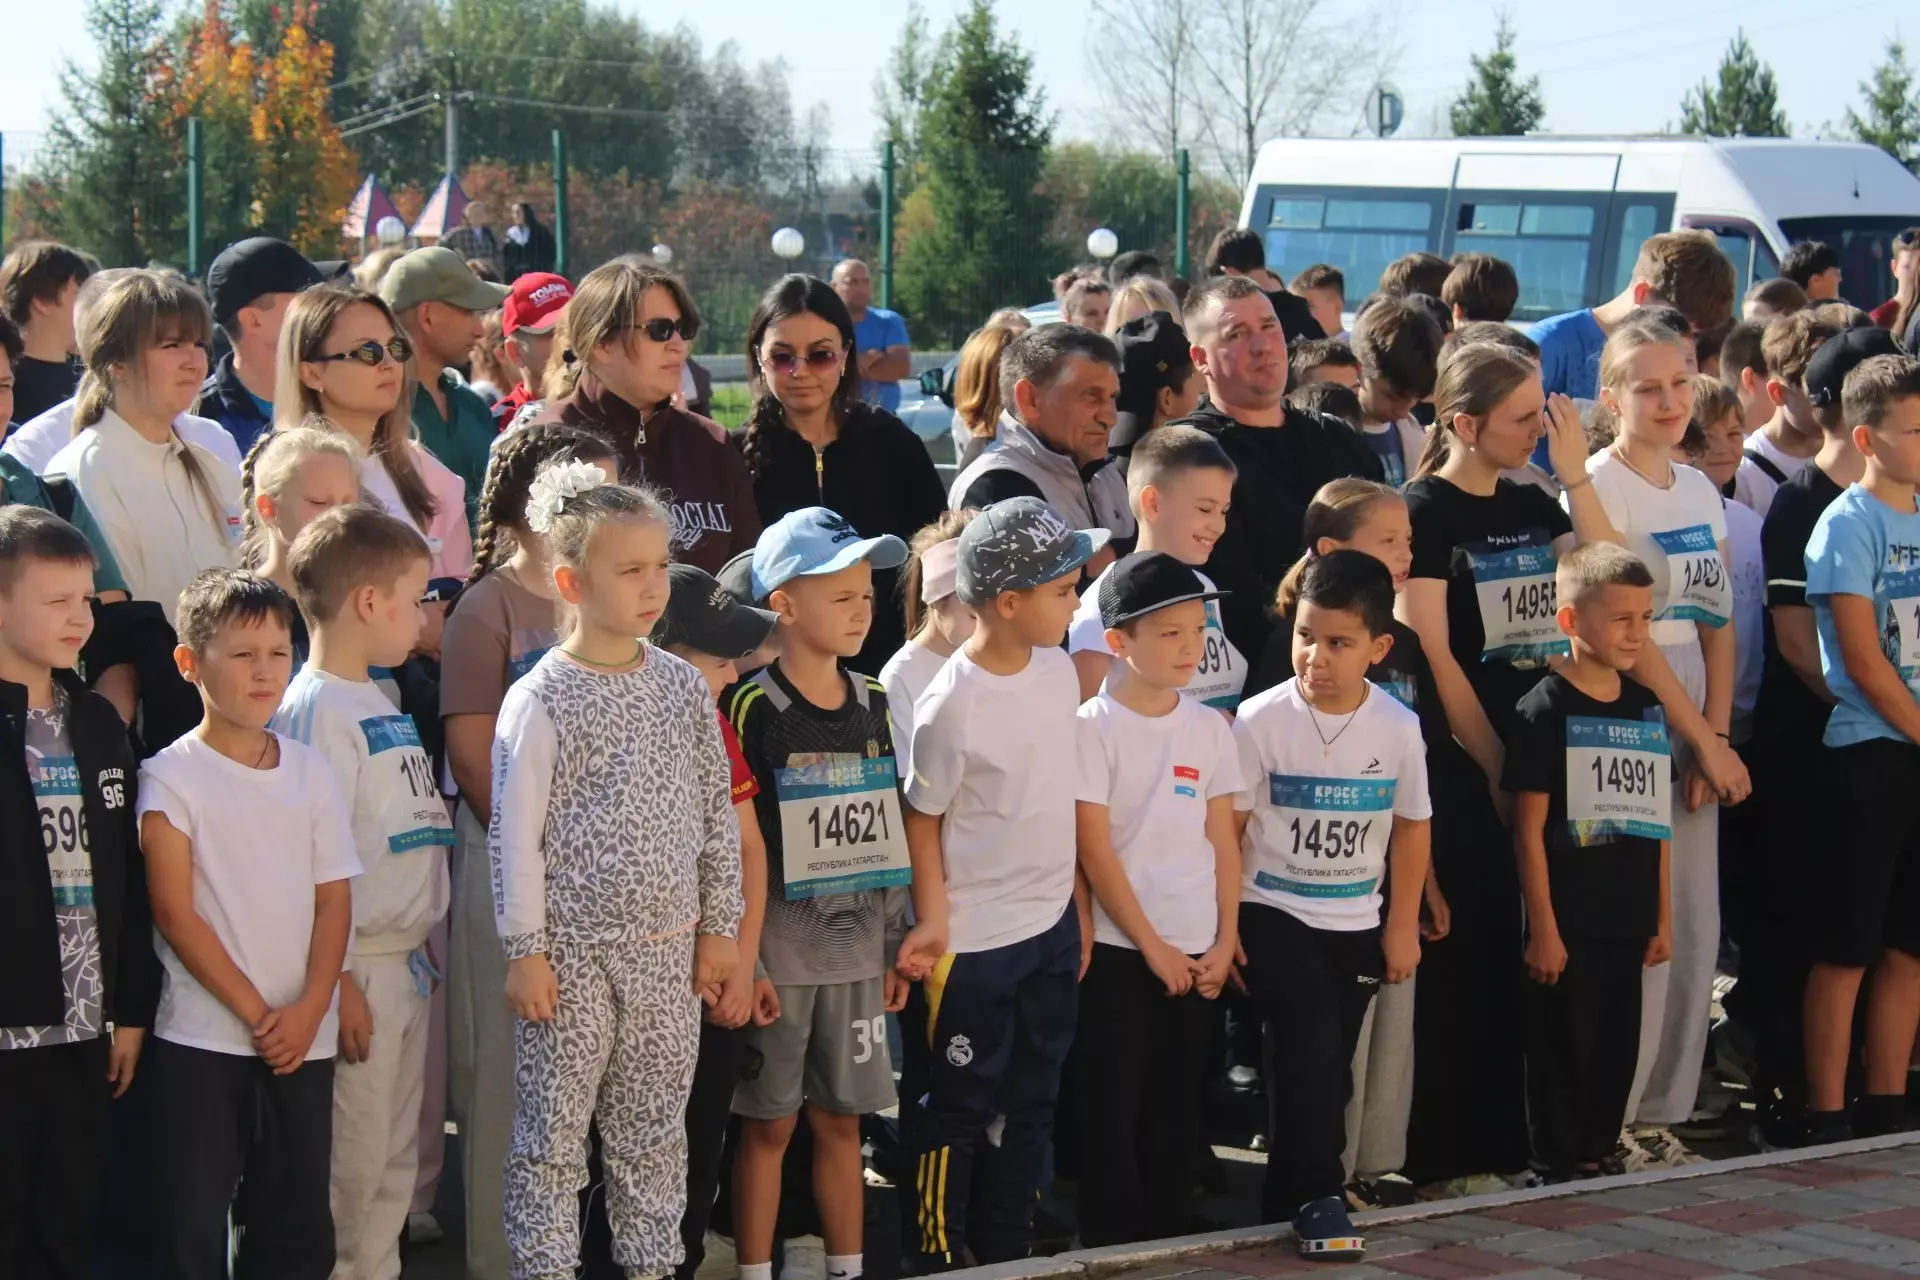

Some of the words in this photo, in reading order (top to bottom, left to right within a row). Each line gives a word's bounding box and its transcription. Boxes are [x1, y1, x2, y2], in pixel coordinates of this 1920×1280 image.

[671, 502, 732, 532] OCIAL
[1608, 726, 1641, 739] КРОСС
[41, 780, 77, 788] НАЦИ
[1592, 755, 1656, 797] 14991
[102, 784, 125, 809] 96
[1315, 785, 1359, 798] КРОСС
[39, 806, 90, 853] 696
[808, 799, 889, 848] 14621
[1290, 817, 1373, 859] 14591
[807, 859, 852, 872] РЕСПУБЛИКА
[852, 854, 889, 867] ТАТАРСТАН
[1285, 863, 1332, 877] РЕСПУБЛИКА
[851, 1014, 886, 1064] 39
